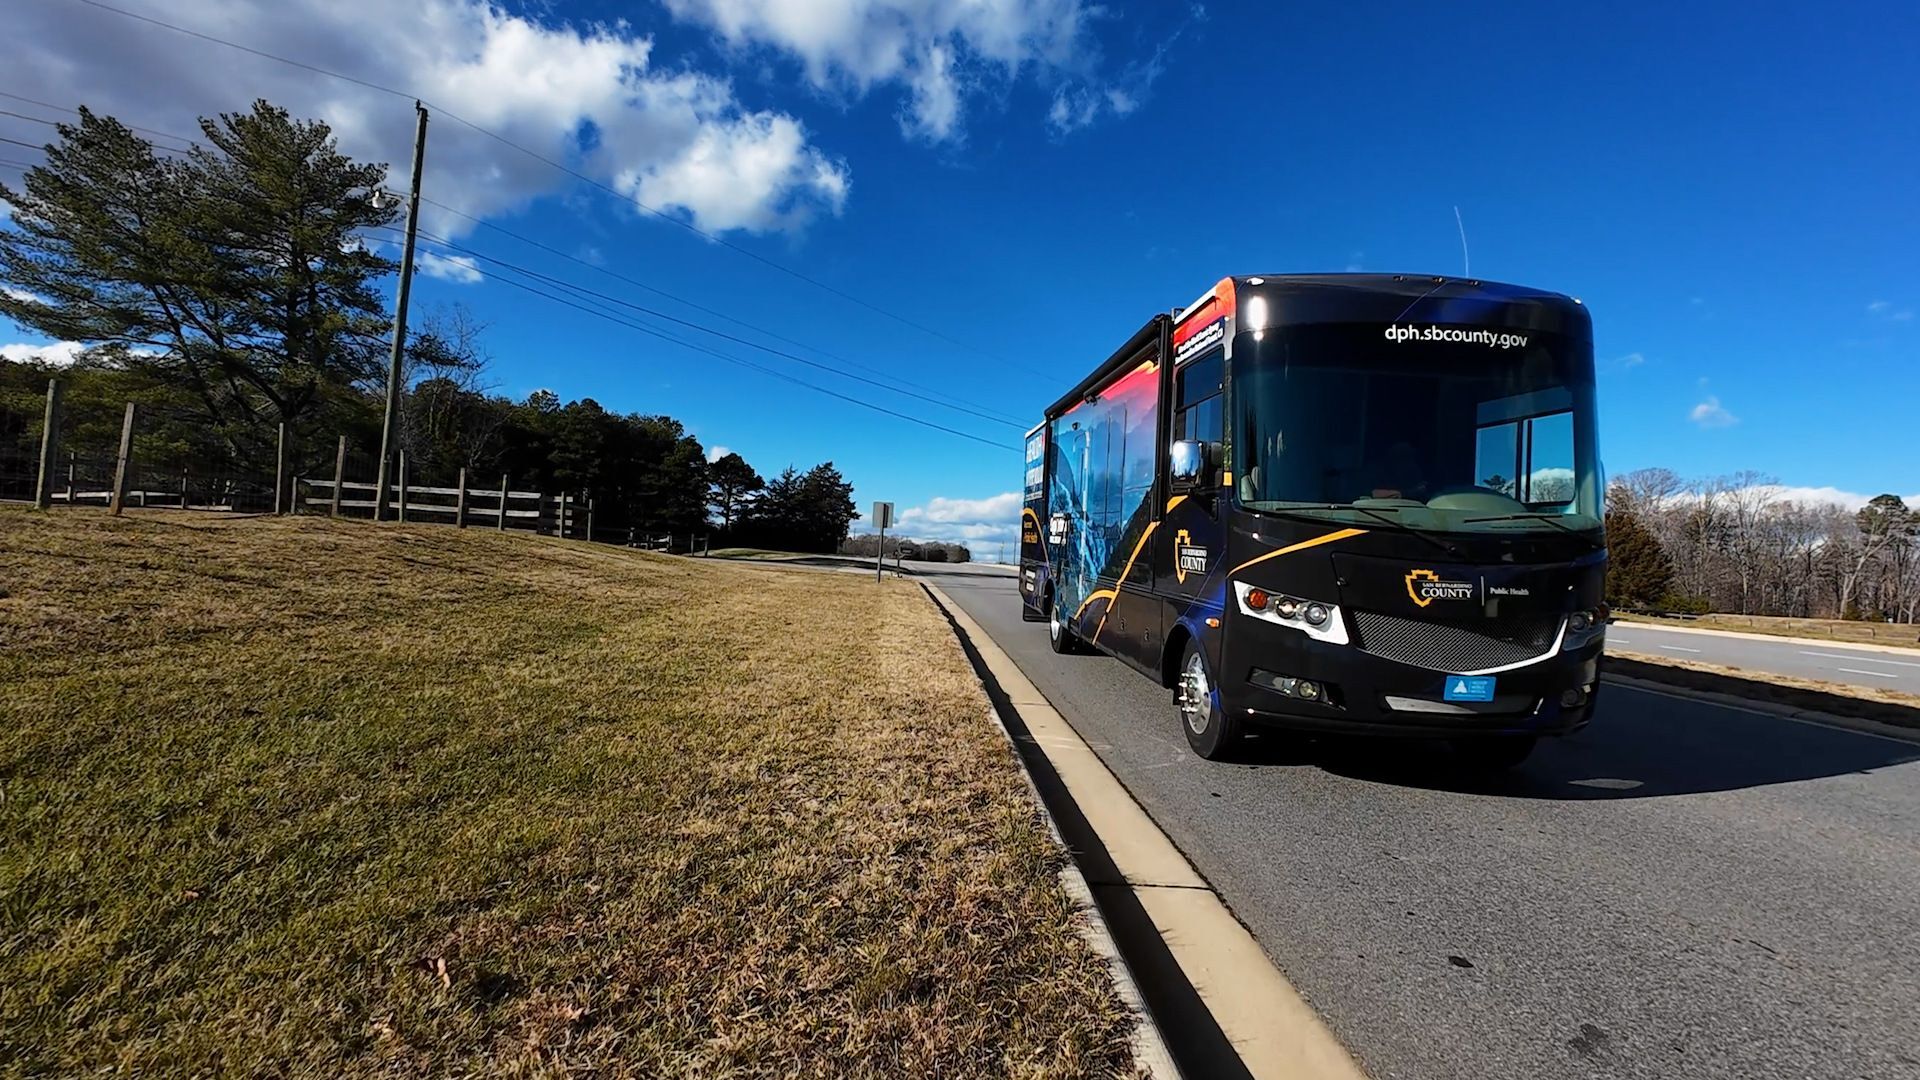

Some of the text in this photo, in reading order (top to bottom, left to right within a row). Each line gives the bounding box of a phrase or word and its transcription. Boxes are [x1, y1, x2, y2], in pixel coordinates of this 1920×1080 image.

[1384, 324, 1528, 349] dph.sbcounty.gov
[1180, 556, 1207, 571] COUNTY
[1421, 588, 1473, 598] COUNTY
[1489, 587, 1530, 596] Public Health
